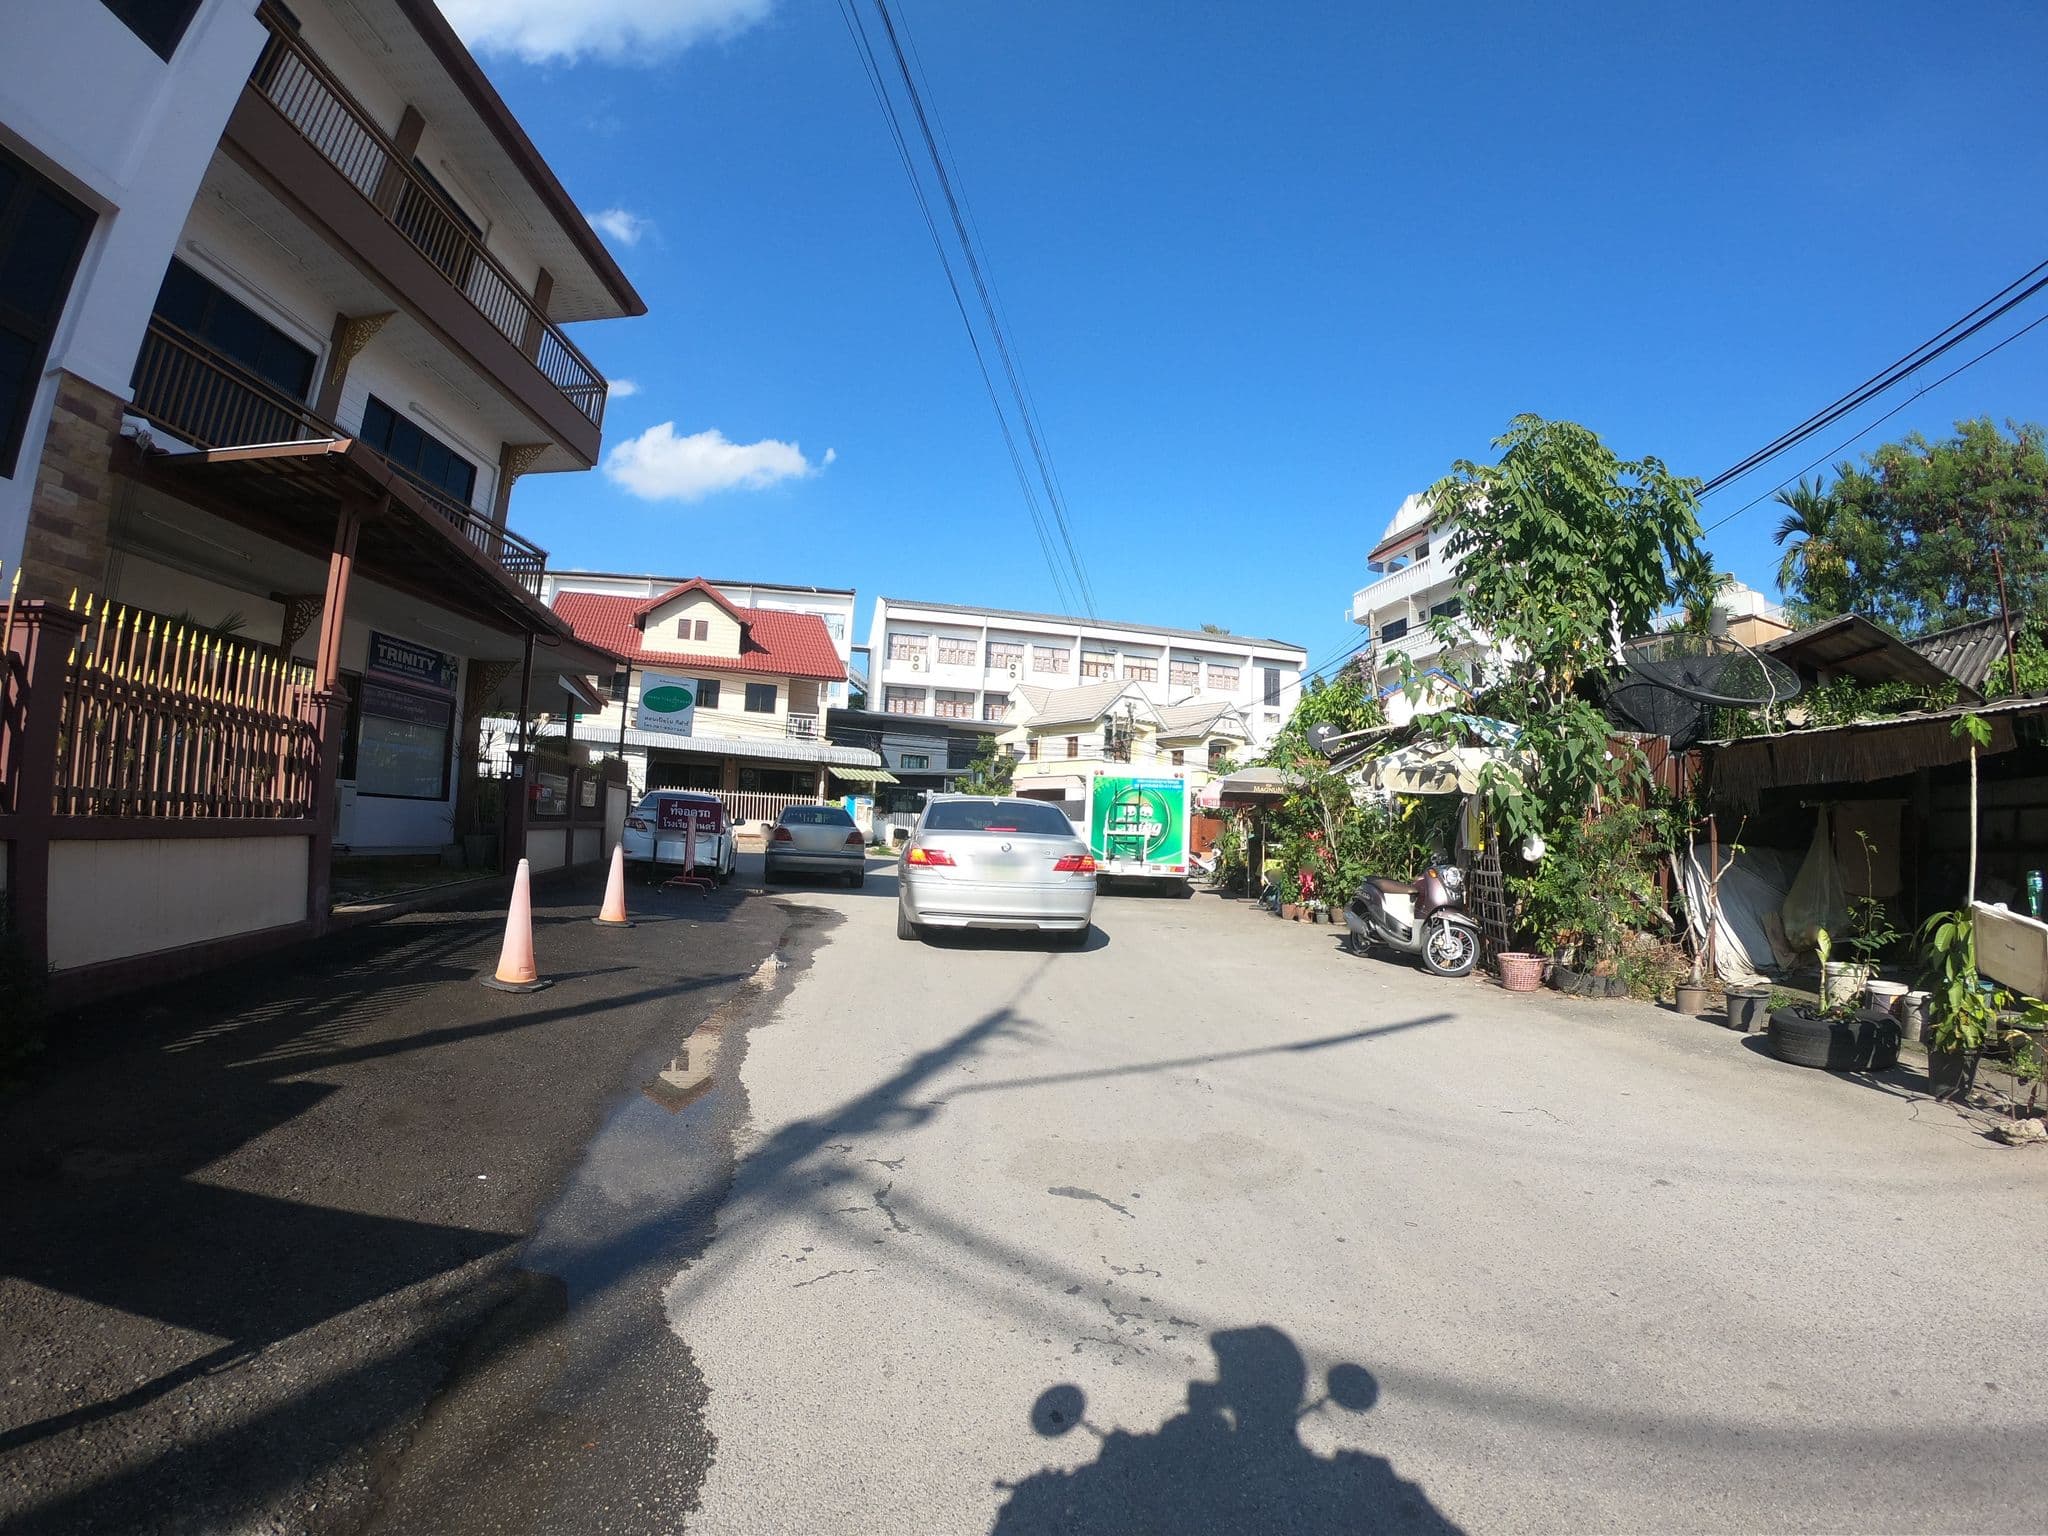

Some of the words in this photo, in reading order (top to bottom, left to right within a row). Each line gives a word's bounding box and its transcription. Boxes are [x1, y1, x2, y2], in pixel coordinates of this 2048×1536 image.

[378, 643, 435, 671] TRINITY
[670, 801, 711, 818] ที่จอดรถ
